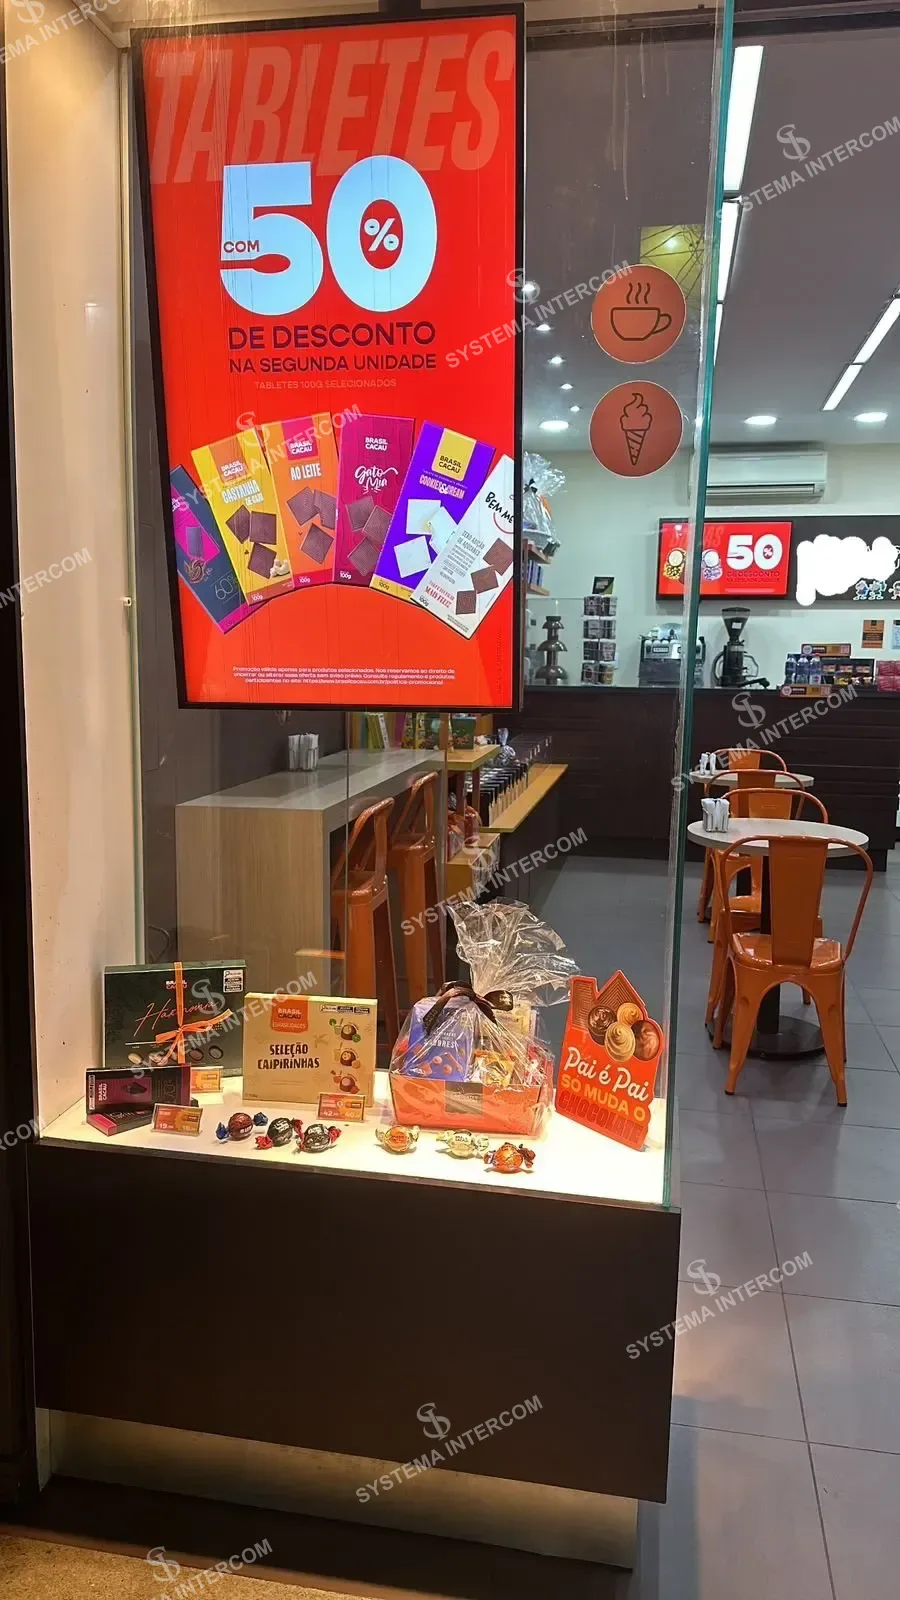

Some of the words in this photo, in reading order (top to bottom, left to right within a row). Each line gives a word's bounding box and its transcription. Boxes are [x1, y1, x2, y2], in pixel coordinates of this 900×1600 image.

[149, 29, 514, 184] TABLETES
[219, 154, 438, 316] 50
[364, 218, 399, 251] %
[223, 240, 260, 253] COM
[229, 326, 265, 350] DE
[273, 321, 436, 349] DESCONTO
[229, 358, 256, 373] NA
[259, 356, 349, 373] SEGUNDA
[353, 354, 436, 371] UNIDADE
[255, 381, 298, 389] TABLETES
[300, 380, 323, 389] 100G
[324, 379, 397, 388] SELECIONADOS
[291, 446, 313, 455] CACAU
[365, 437, 389, 445] BRASIL
[365, 443, 387, 451] CACAU
[438, 462, 460, 474] CACAU
[440, 455, 462, 468] BRASIL
[290, 465, 301, 481] AO
[302, 463, 322, 479] LEITE
[355, 465, 398, 485] Gato
[222, 480, 260, 503] CASTANHA
[485, 491, 502, 514] BEM
[727, 534, 783, 570] 50
[270, 1042, 308, 1058] SELEÇÃO
[257, 1057, 320, 1070] CAIPIRINHAS
[564, 1046, 596, 1079] Pai
[599, 1064, 611, 1085] é
[612, 1067, 649, 1101] Pai
[561, 1073, 581, 1093] SÓ
[584, 1084, 629, 1116] MUDA
[634, 1106, 646, 1122] O
[559, 1089, 645, 1144] CHOCOLATE
